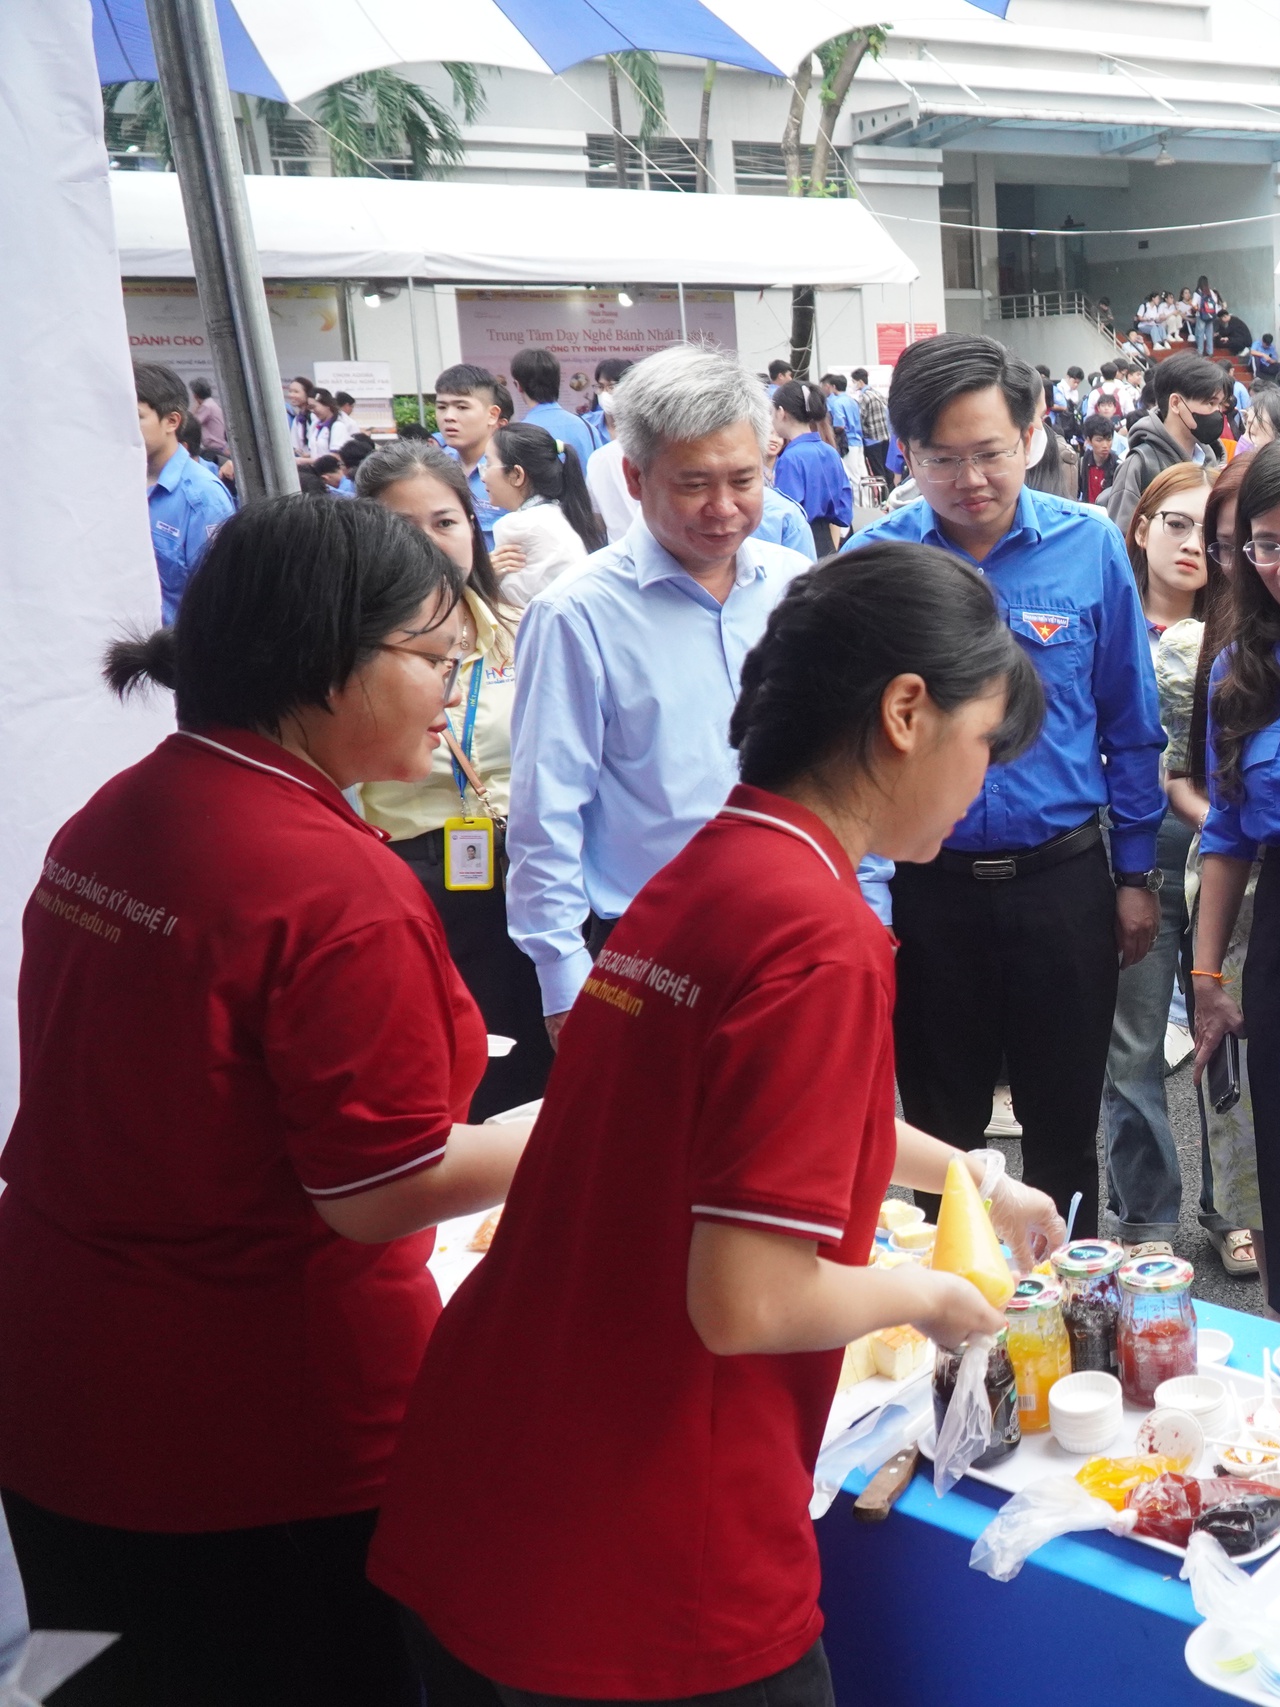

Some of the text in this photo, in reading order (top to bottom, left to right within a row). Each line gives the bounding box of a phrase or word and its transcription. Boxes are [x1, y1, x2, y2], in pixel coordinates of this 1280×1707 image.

[130, 332, 204, 346] DÀNH CHO
[485, 328, 525, 345] Trung
[526, 328, 553, 341] Tâm
[556, 328, 579, 344] Dạy
[582, 327, 613, 344] Nghề
[615, 328, 645, 341] Bánh
[647, 327, 674, 341] Nhất
[545, 344, 569, 353] CÔNG
[583, 345, 606, 353] TNHH
[35, 887, 121, 944] www.hvct.edu.vn
[54, 866, 77, 890] CAO
[122, 898, 166, 934] NGHỆ
[163, 915, 178, 937] II
[645, 963, 690, 1007] NGHỆ
[686, 984, 702, 1009] II
